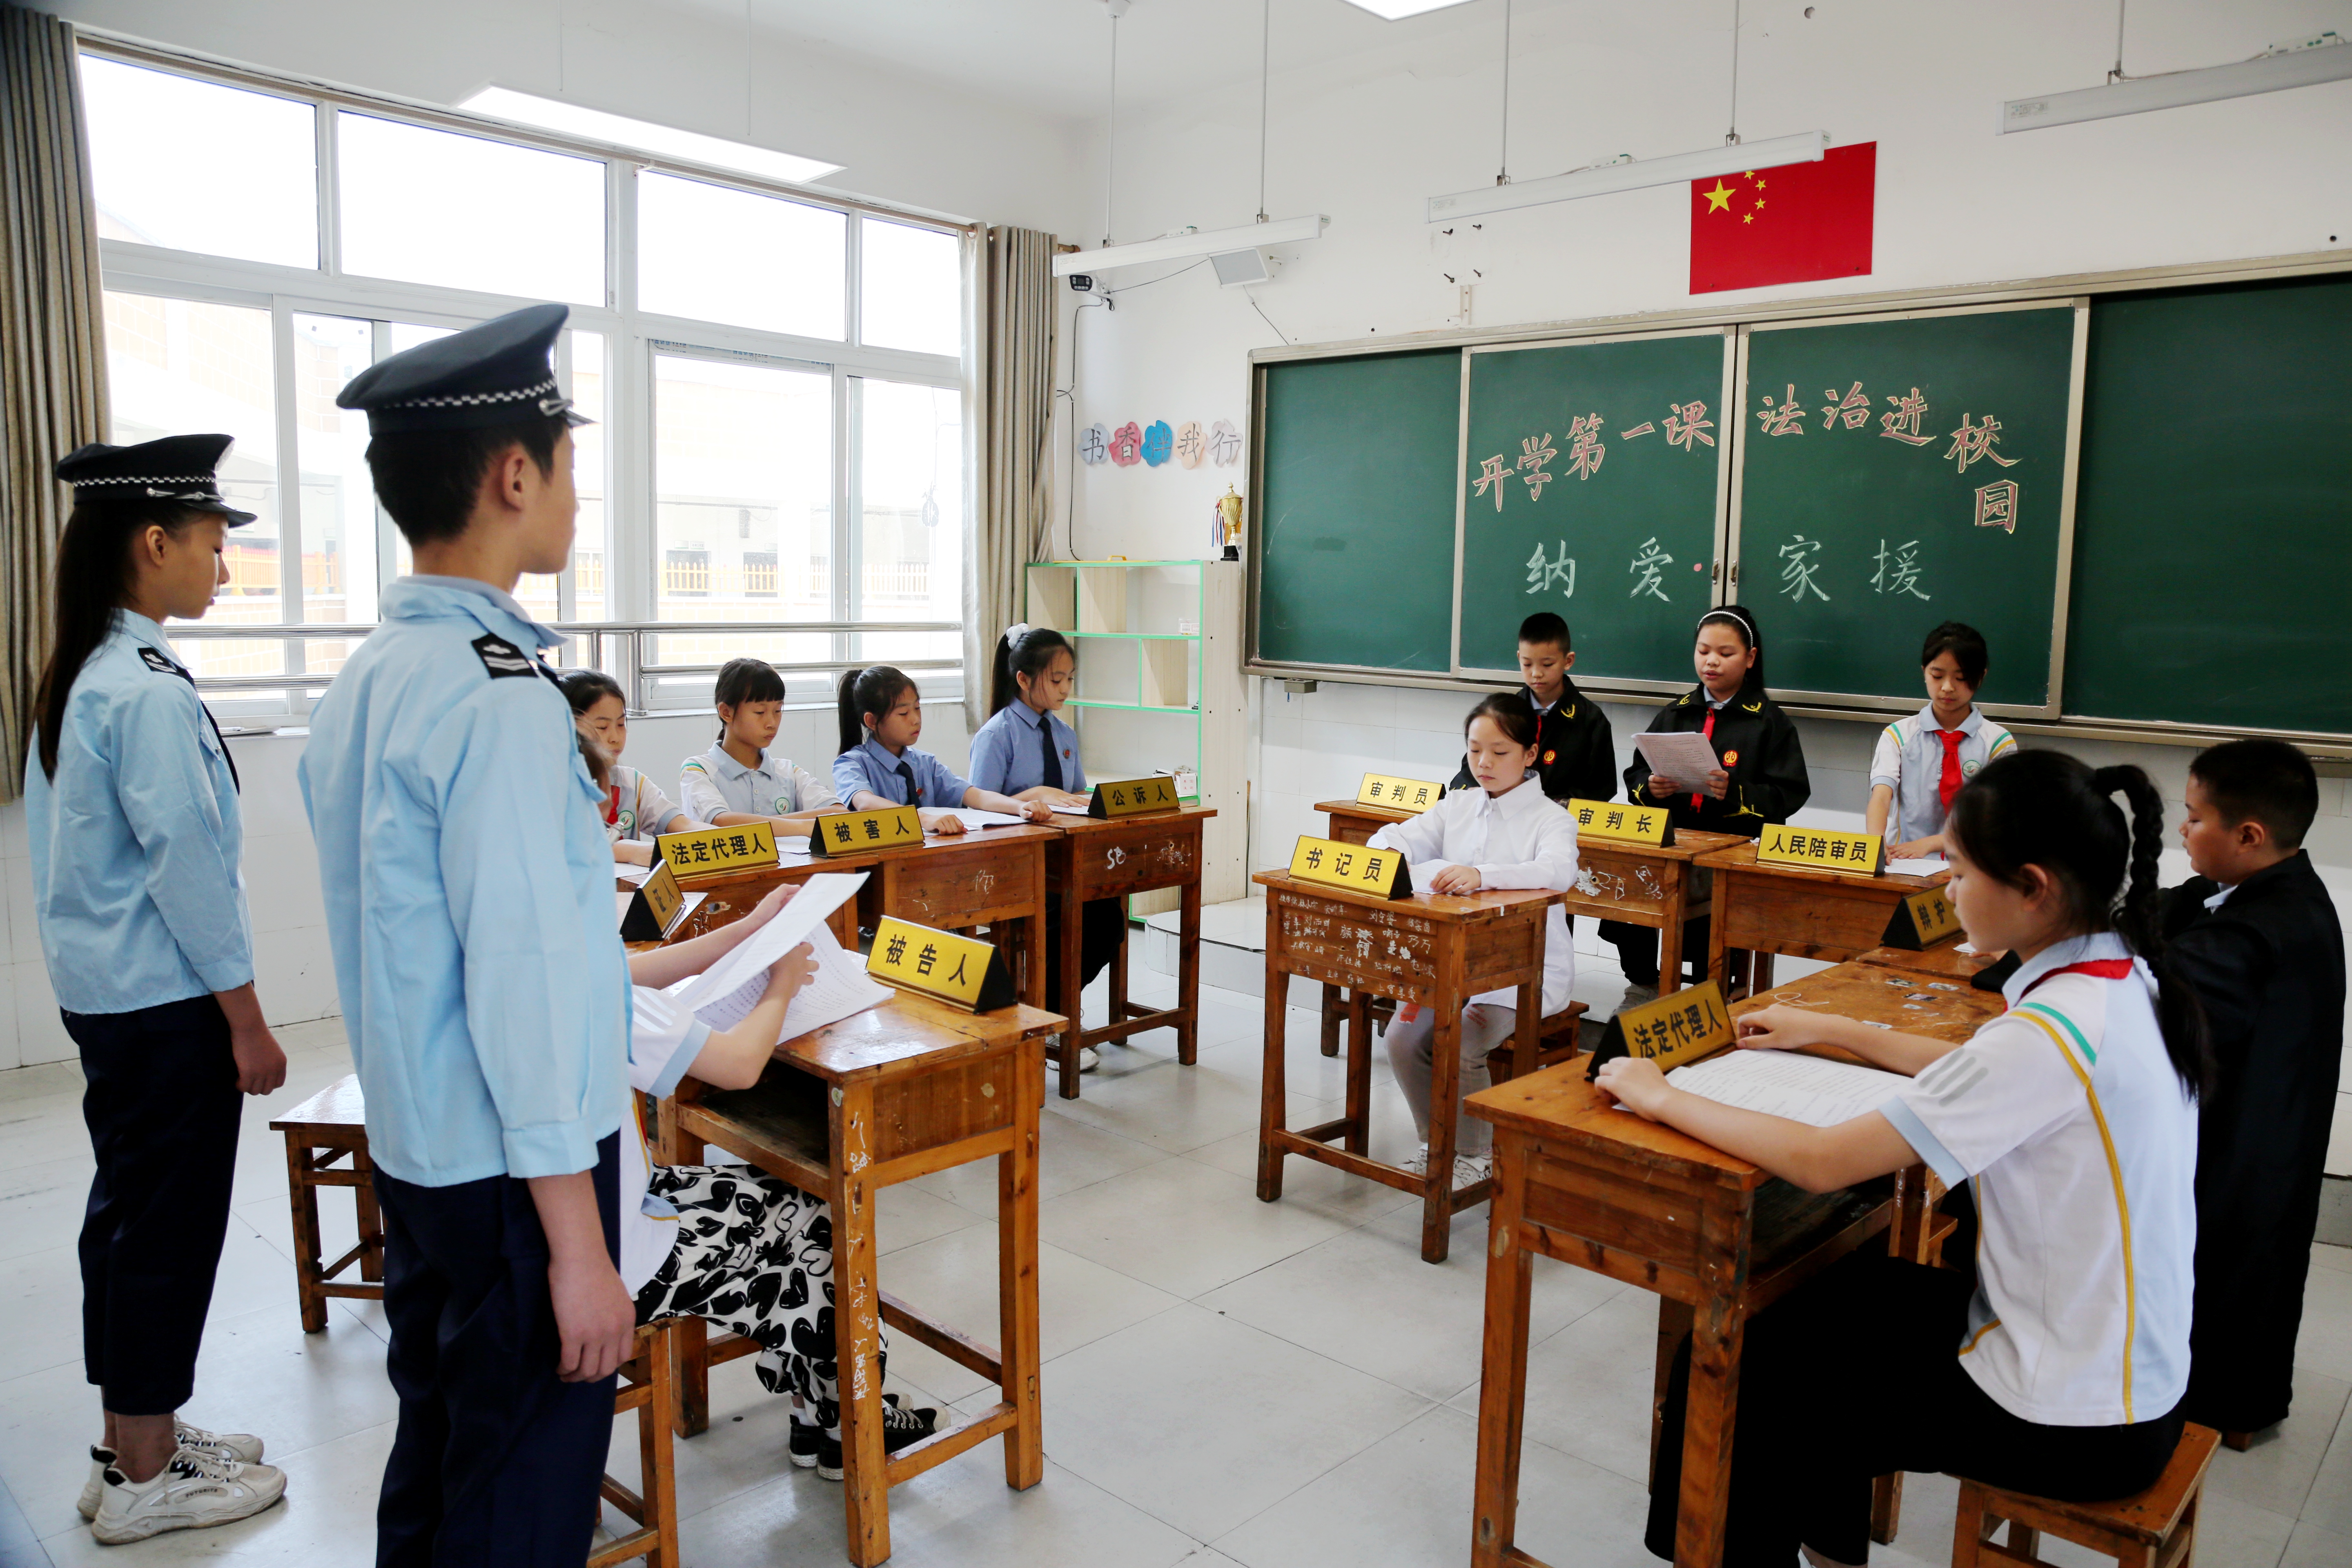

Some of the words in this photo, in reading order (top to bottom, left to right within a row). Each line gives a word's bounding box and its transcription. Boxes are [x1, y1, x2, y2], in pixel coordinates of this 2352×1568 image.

[1082, 423, 1241, 464] 书香伴我行
[1472, 401, 1715, 512] 开学第一课
[1757, 381, 2021, 534] 法治进校园
[1112, 784, 1169, 806] 公诉人
[1370, 780, 1429, 806] 审判员
[834, 816, 910, 843] 被害人
[1578, 808, 1652, 834] 审判长
[671, 833, 768, 865] 法定代理人
[1768, 833, 1867, 862] 人民陪审员
[1306, 847, 1382, 882] 书记员
[886, 933, 967, 986] 被告人
[1634, 999, 1723, 1059] 法定代理人
